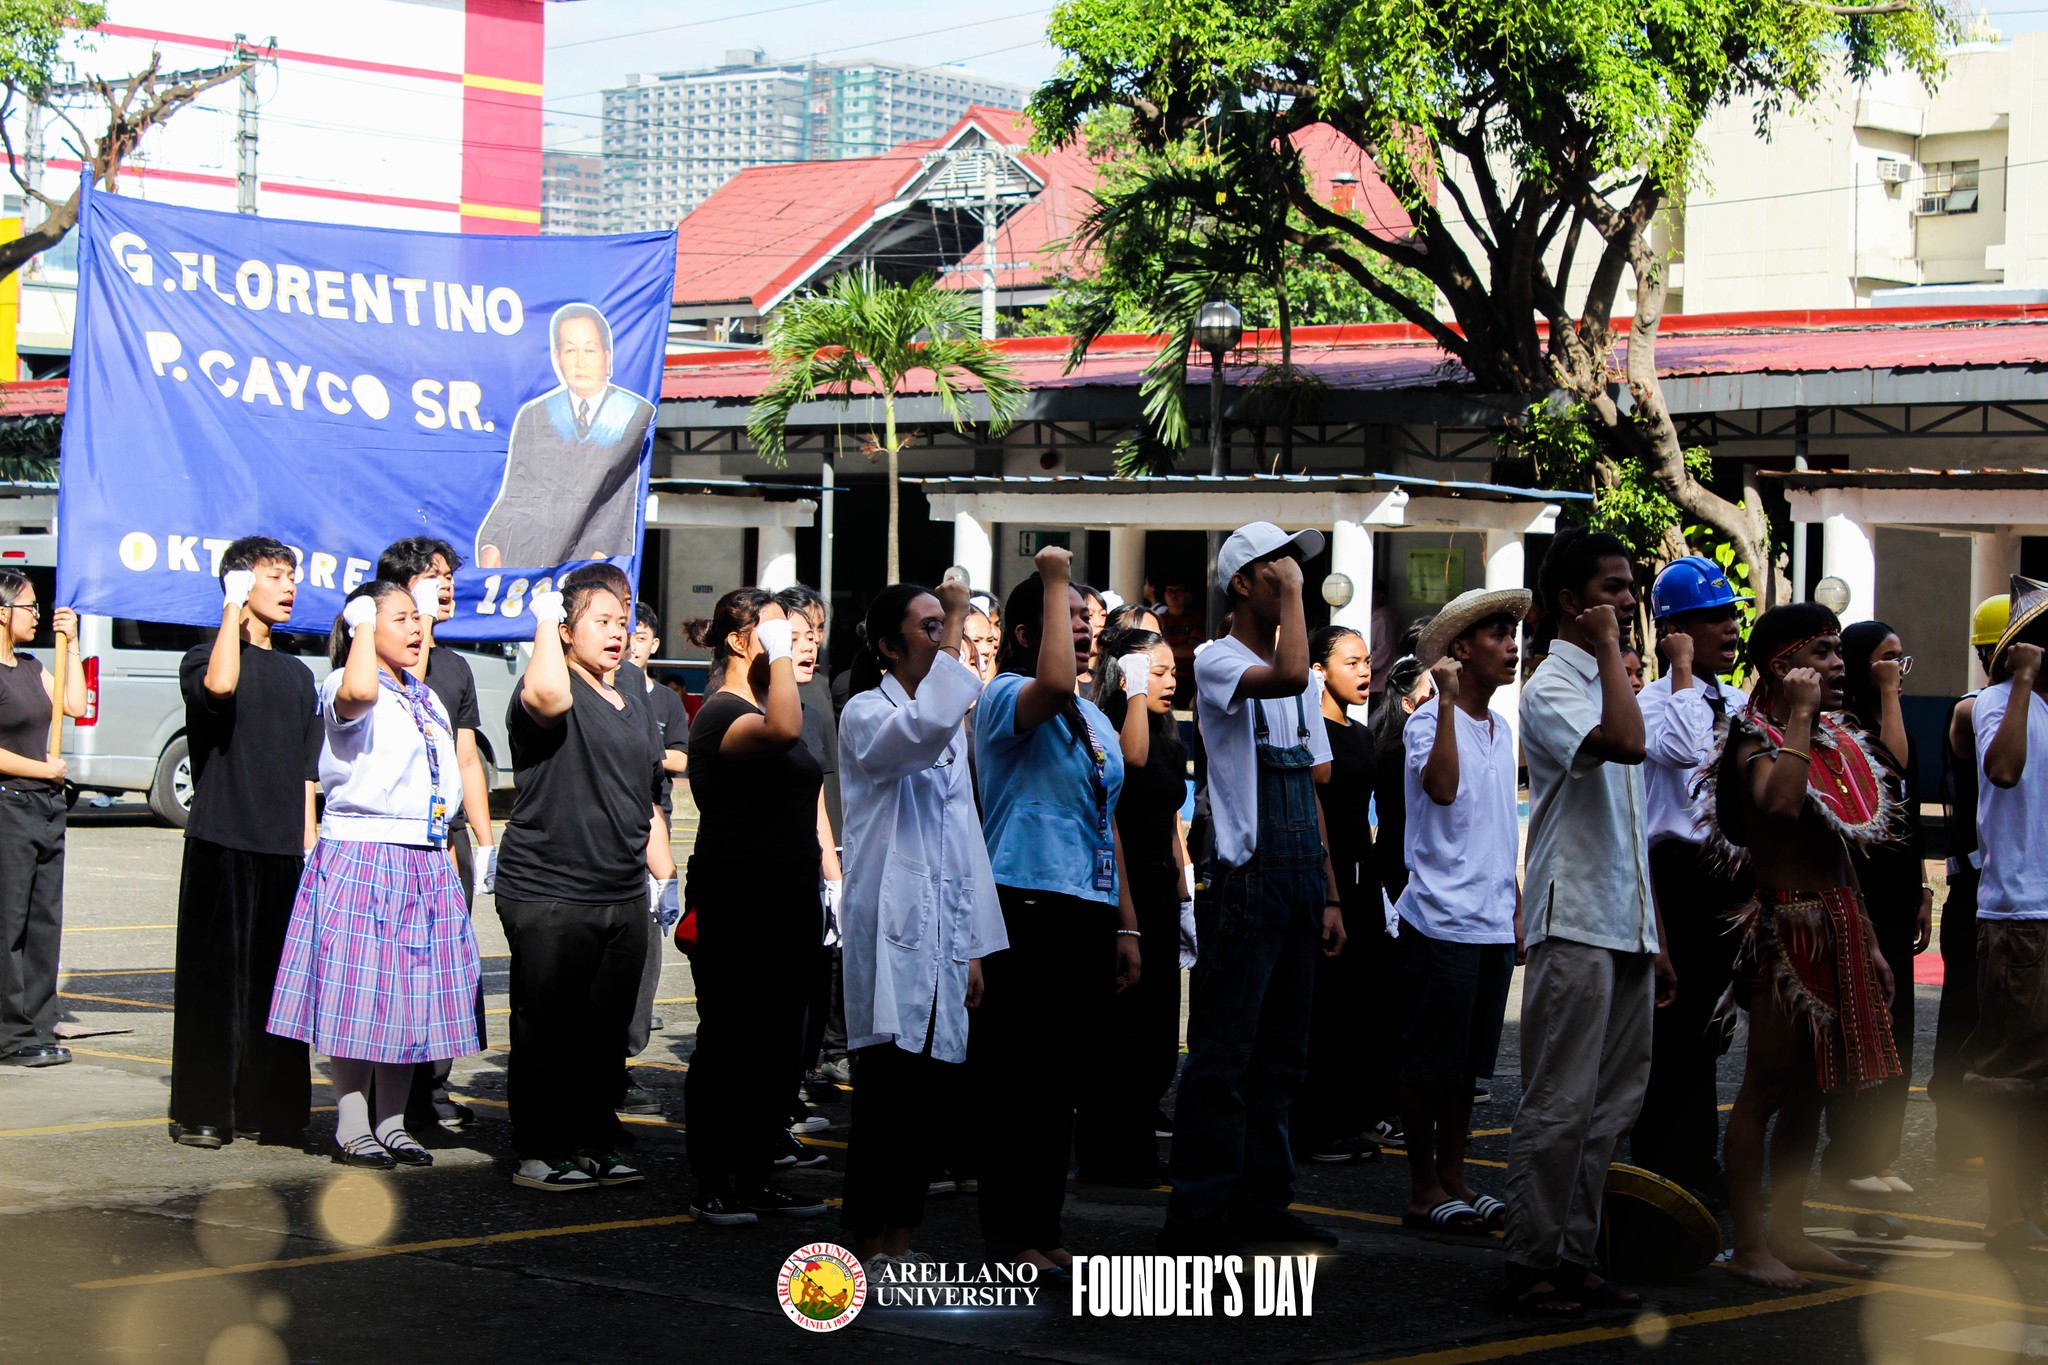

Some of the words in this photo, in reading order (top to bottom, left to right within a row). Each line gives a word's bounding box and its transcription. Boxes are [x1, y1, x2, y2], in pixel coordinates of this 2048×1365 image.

[145, 331, 188, 382] P.
[198, 350, 391, 420] CAYCO
[411, 378, 495, 433] SR.
